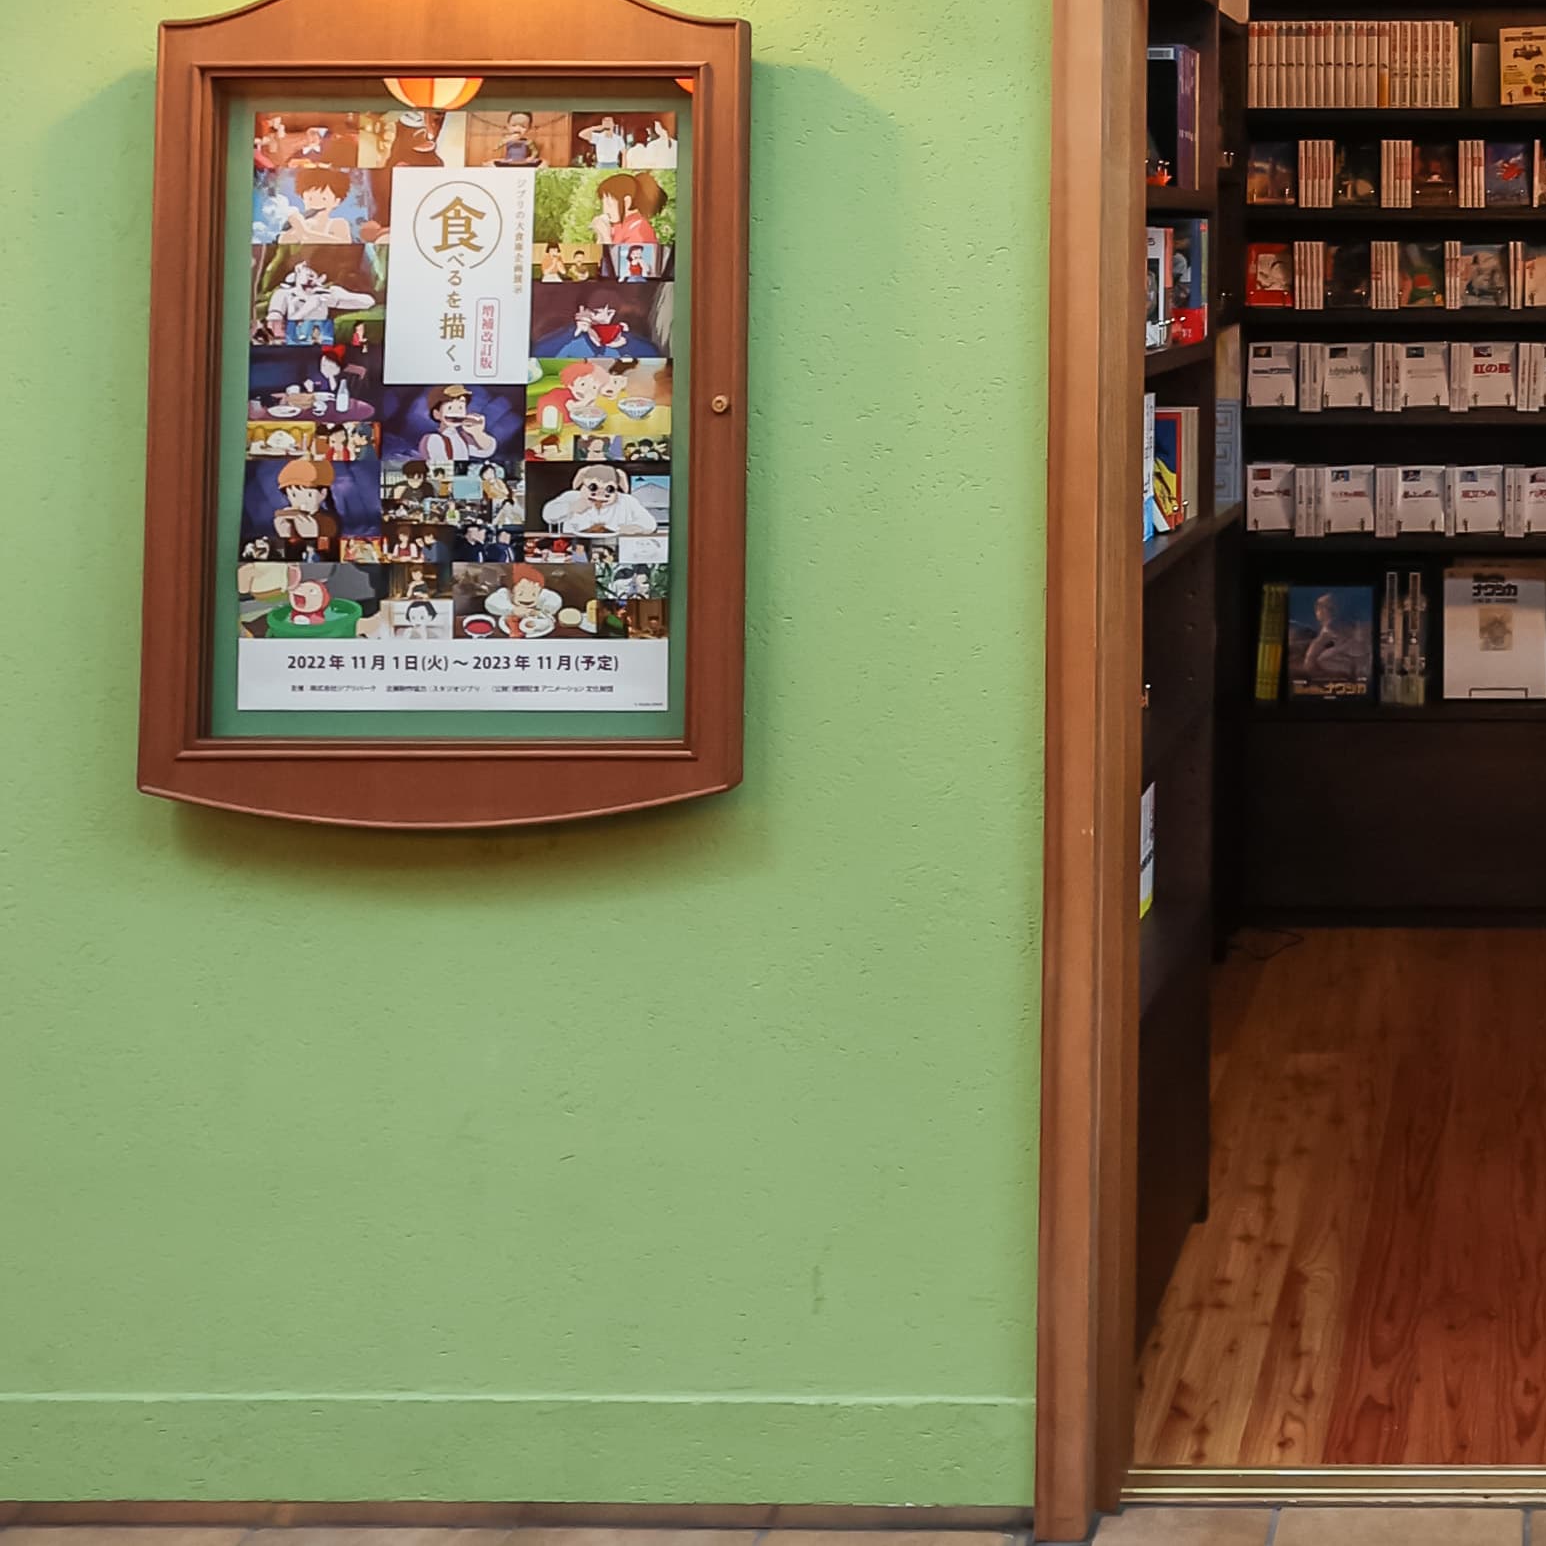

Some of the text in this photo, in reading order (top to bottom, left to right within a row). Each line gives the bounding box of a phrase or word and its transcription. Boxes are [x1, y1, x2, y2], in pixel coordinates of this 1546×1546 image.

[479, 304, 495, 369] 増補改訂版
